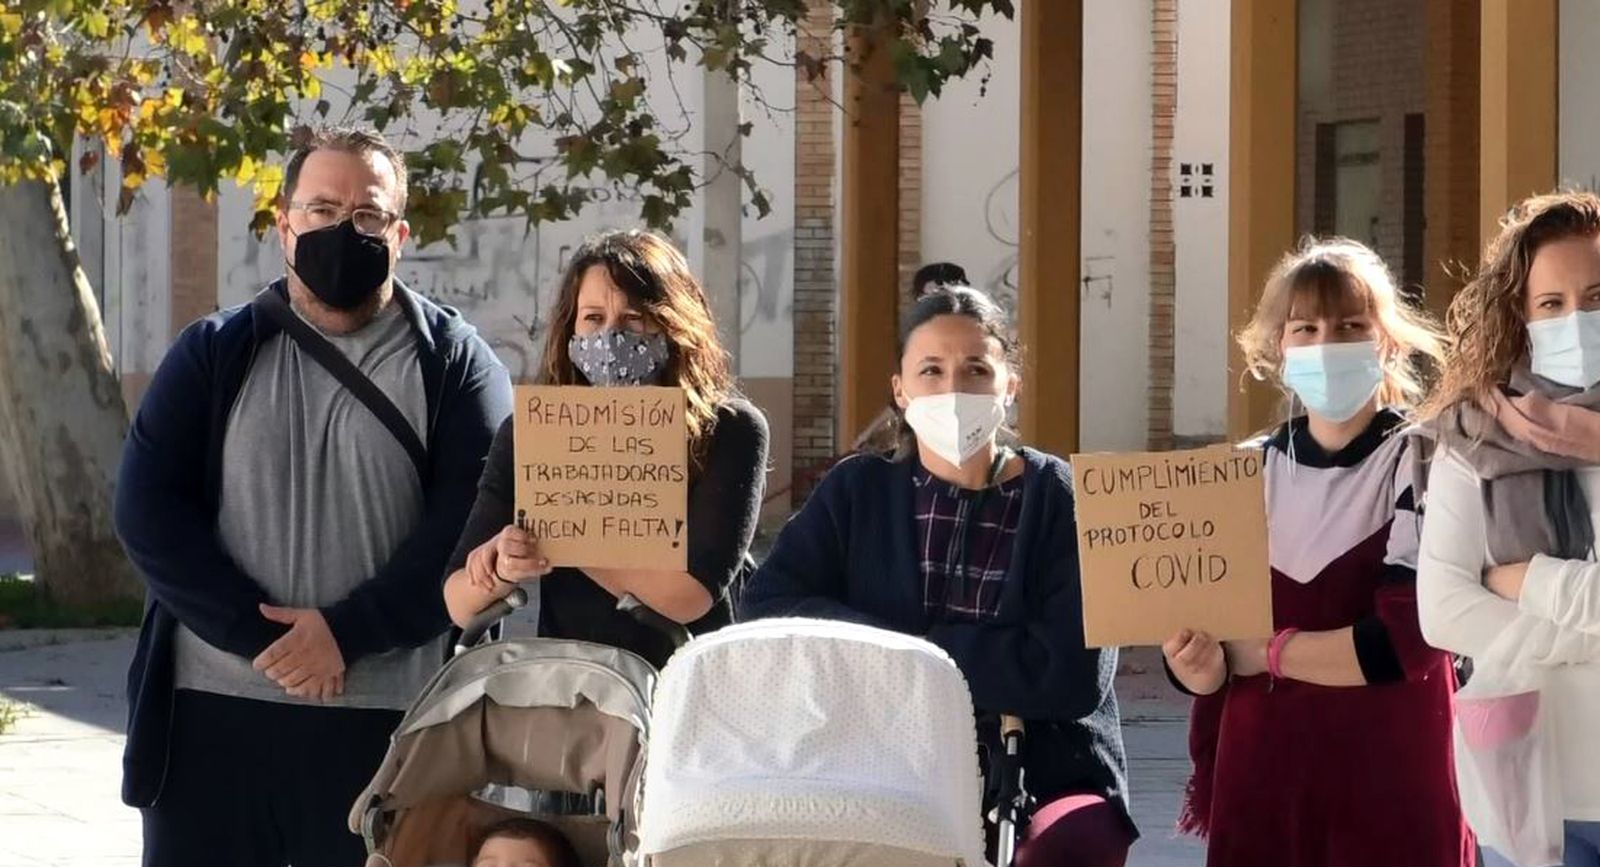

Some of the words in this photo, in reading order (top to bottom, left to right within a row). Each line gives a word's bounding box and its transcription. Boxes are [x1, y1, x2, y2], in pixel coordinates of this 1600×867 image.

[568, 436, 597, 453] DE
[612, 436, 654, 455] LAS
[523, 463, 684, 482] TRABAJADORAS
[1139, 502, 1177, 520] DEL
[1083, 520, 1215, 549] PROTOCOLO
[1131, 548, 1227, 590] COVID
